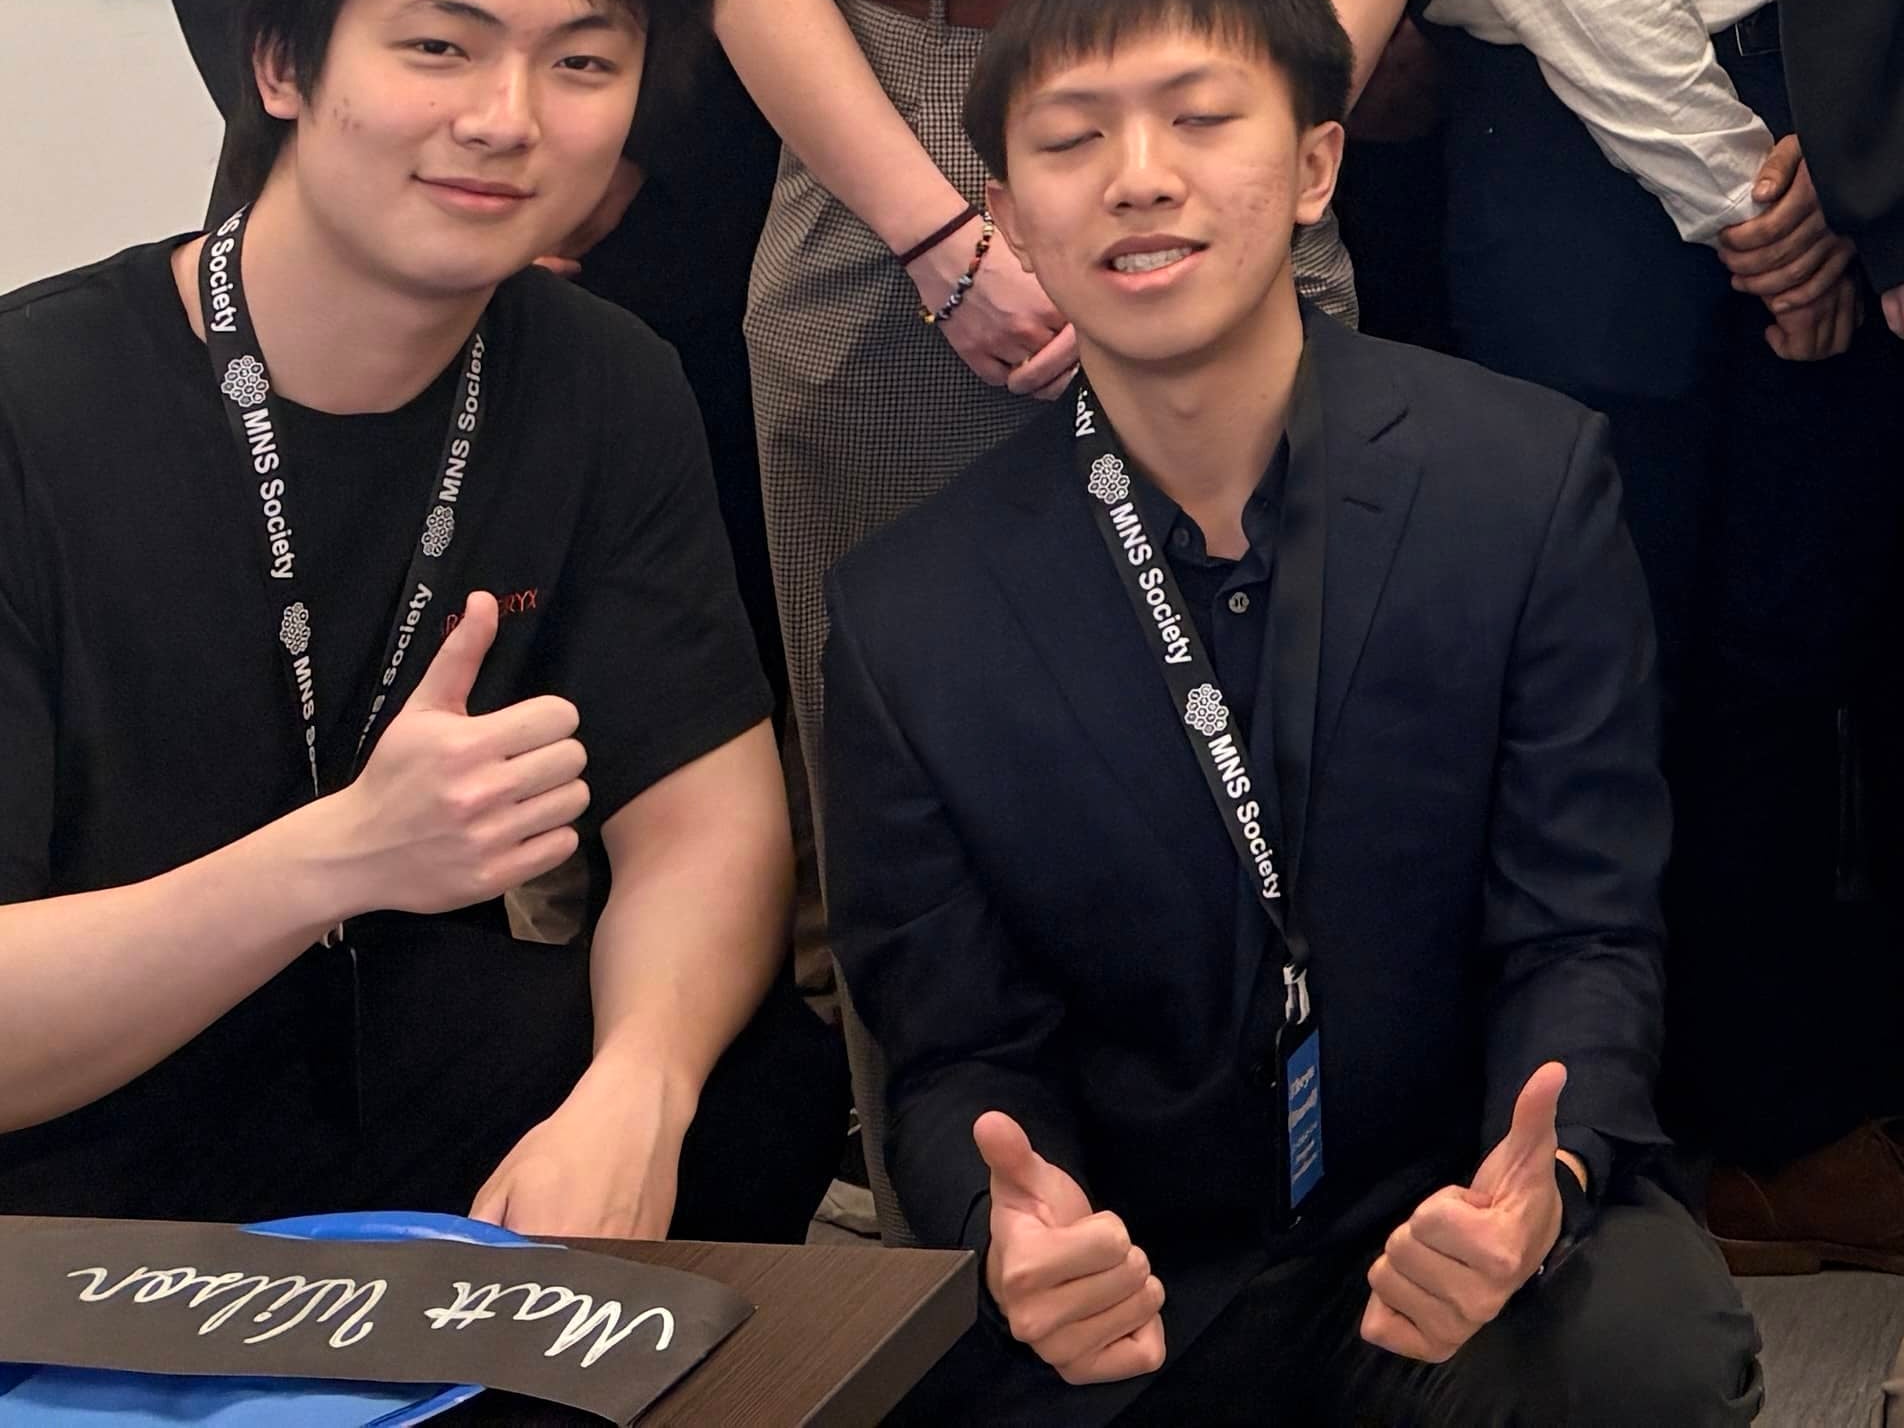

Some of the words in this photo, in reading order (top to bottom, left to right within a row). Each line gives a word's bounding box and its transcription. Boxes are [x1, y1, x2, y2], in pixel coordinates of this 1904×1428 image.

[209, 237, 237, 333] Society
[242, 409, 279, 475] MNS
[440, 439, 470, 503] MNS
[457, 332, 485, 434] Society
[260, 478, 293, 580] Society
[1109, 502, 1153, 568] MNS
[1138, 566, 1192, 666] Society
[383, 581, 432, 690] Society
[292, 655, 315, 719] MNS
[1208, 734, 1252, 800] MNS
[1236, 799, 1281, 901] Society
[66, 1265, 389, 1350] Wilson
[424, 1279, 675, 1369] Matt
